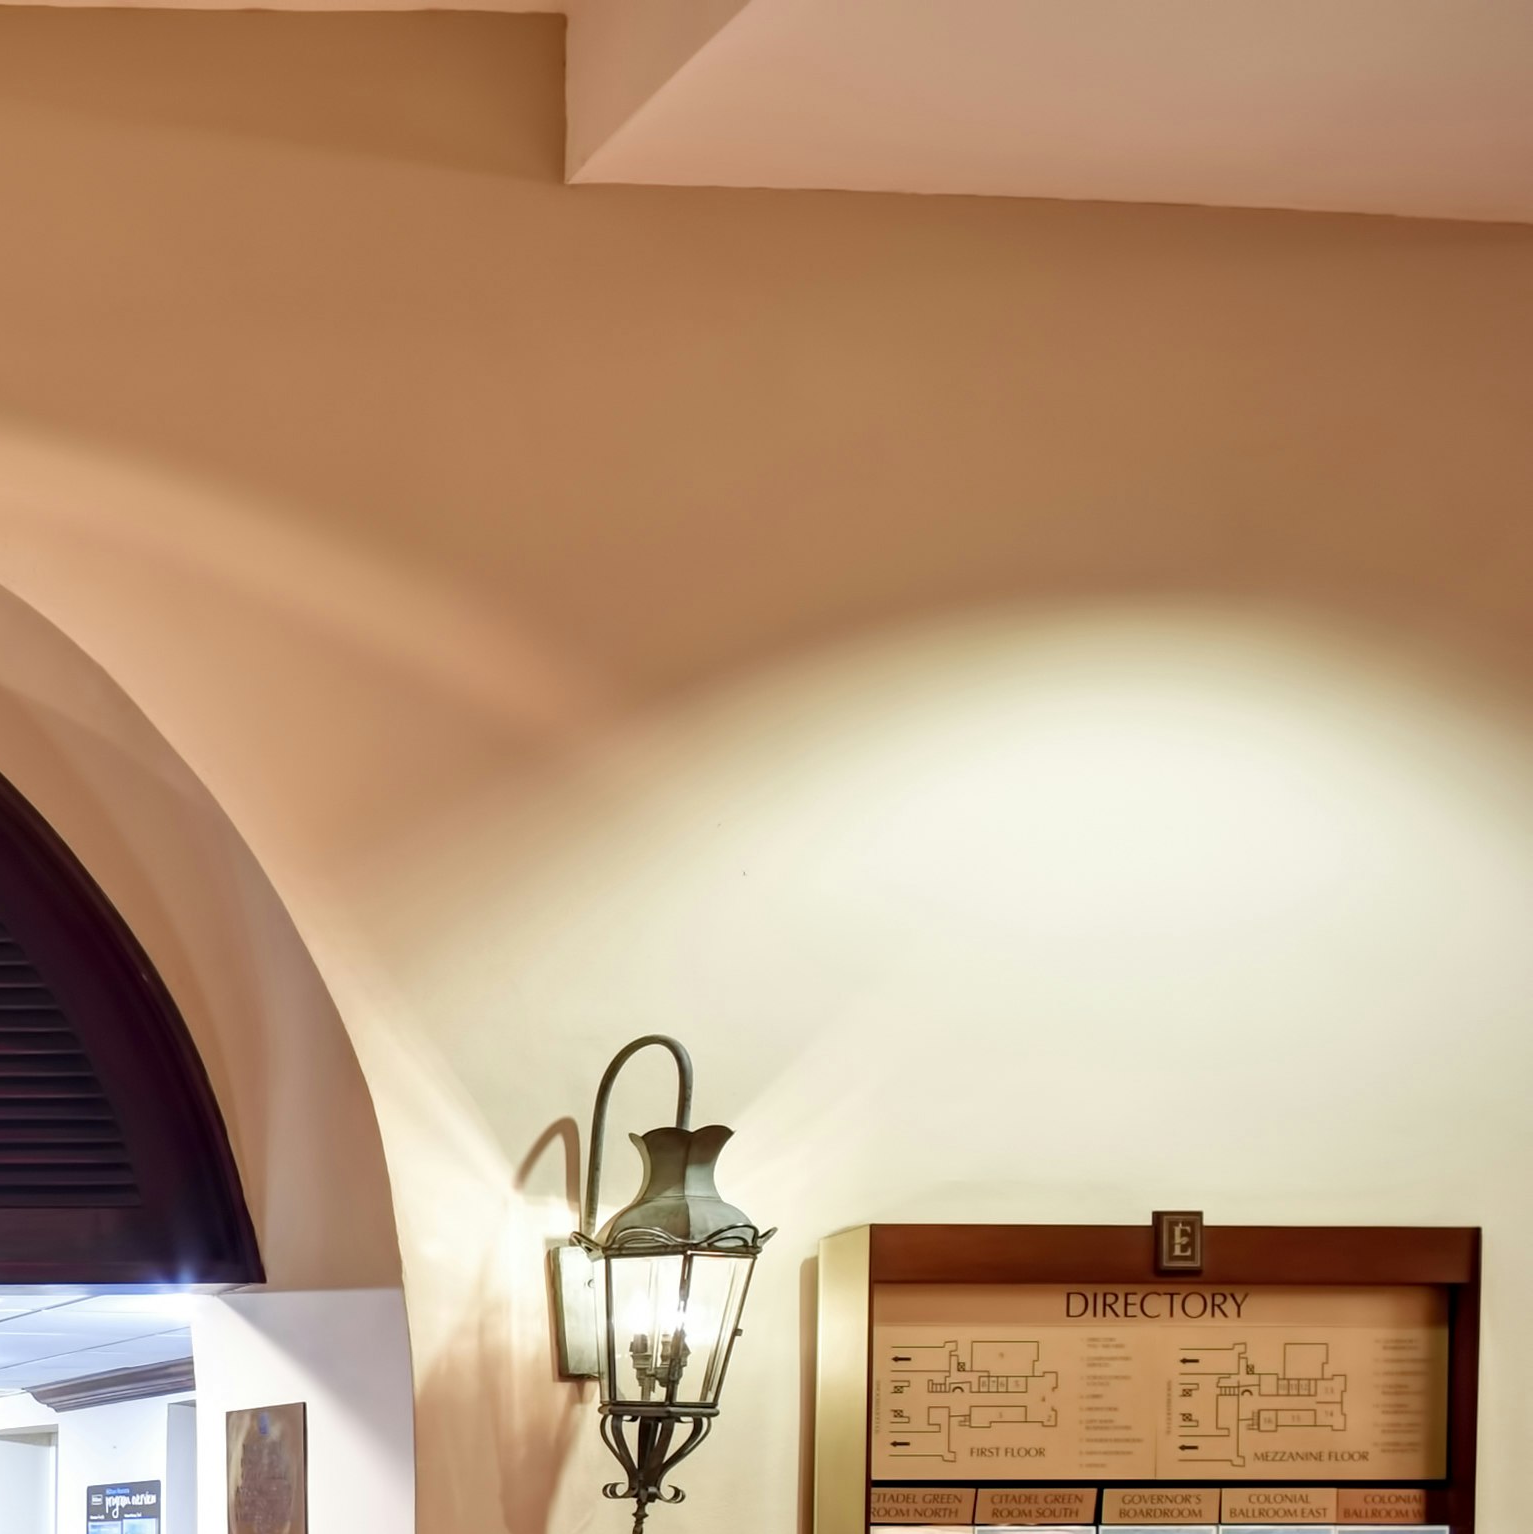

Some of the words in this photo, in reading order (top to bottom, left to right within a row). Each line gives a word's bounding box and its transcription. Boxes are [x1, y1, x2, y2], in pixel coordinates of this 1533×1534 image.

[1065, 1291, 1249, 1318] DIRECTORY
[970, 1447, 1001, 1458] FIRST
[1004, 1447, 1046, 1459] FLOOR
[1253, 1451, 1325, 1462] MEZZANINE
[1328, 1451, 1369, 1462] FLOOR
[922, 1493, 963, 1504] GREEN
[991, 1493, 1039, 1504] CITADEL
[1044, 1493, 1083, 1504] GREEN
[1122, 1493, 1202, 1505] GOVERNOR'S
[1248, 1493, 1310, 1505] COLONIAL
[913, 1507, 959, 1518] NORTH
[992, 1507, 1033, 1518] ROOM
[1035, 1507, 1079, 1518] SOUTH
[1119, 1507, 1202, 1519] BOARDROOM
[1229, 1507, 1298, 1518] BALLROOM
[1301, 1507, 1328, 1518] EAST
[1343, 1508, 1409, 1519] BALLROOM
